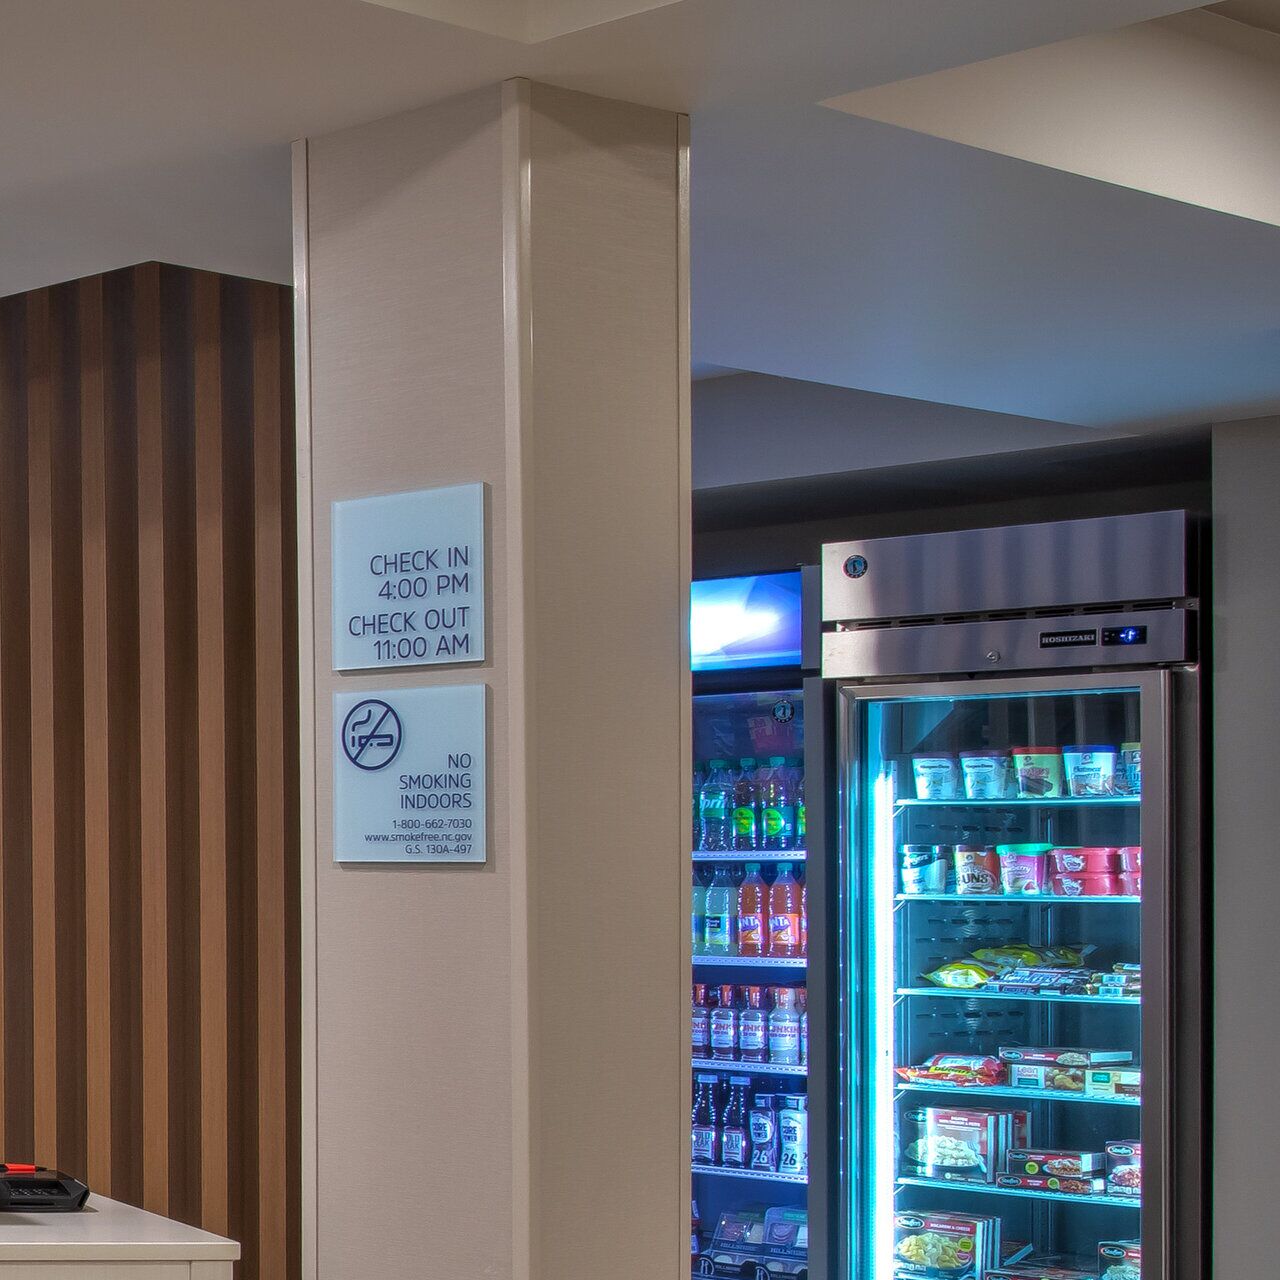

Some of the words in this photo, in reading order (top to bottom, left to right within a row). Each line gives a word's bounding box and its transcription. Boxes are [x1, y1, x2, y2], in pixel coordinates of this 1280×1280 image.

[370, 549, 439, 576] CHECK
[447, 545, 469, 567] IN
[378, 576, 428, 600] 4:00
[437, 572, 469, 596] PM
[348, 611, 417, 637] CHECK
[424, 606, 470, 630] OUT
[373, 636, 427, 660] 11:00
[435, 633, 469, 656] AM
[447, 753, 472, 769] NO
[399, 773, 472, 790] SMOKING
[400, 792, 472, 809] INDOORS
[392, 818, 473, 829] 1-800-662-7030
[364, 832, 473, 843] www.smokefree.nc.gov
[405, 844, 423, 855] G.S.
[426, 844, 473, 855] 130A-497
[782, 1152, 797, 1166] 26
